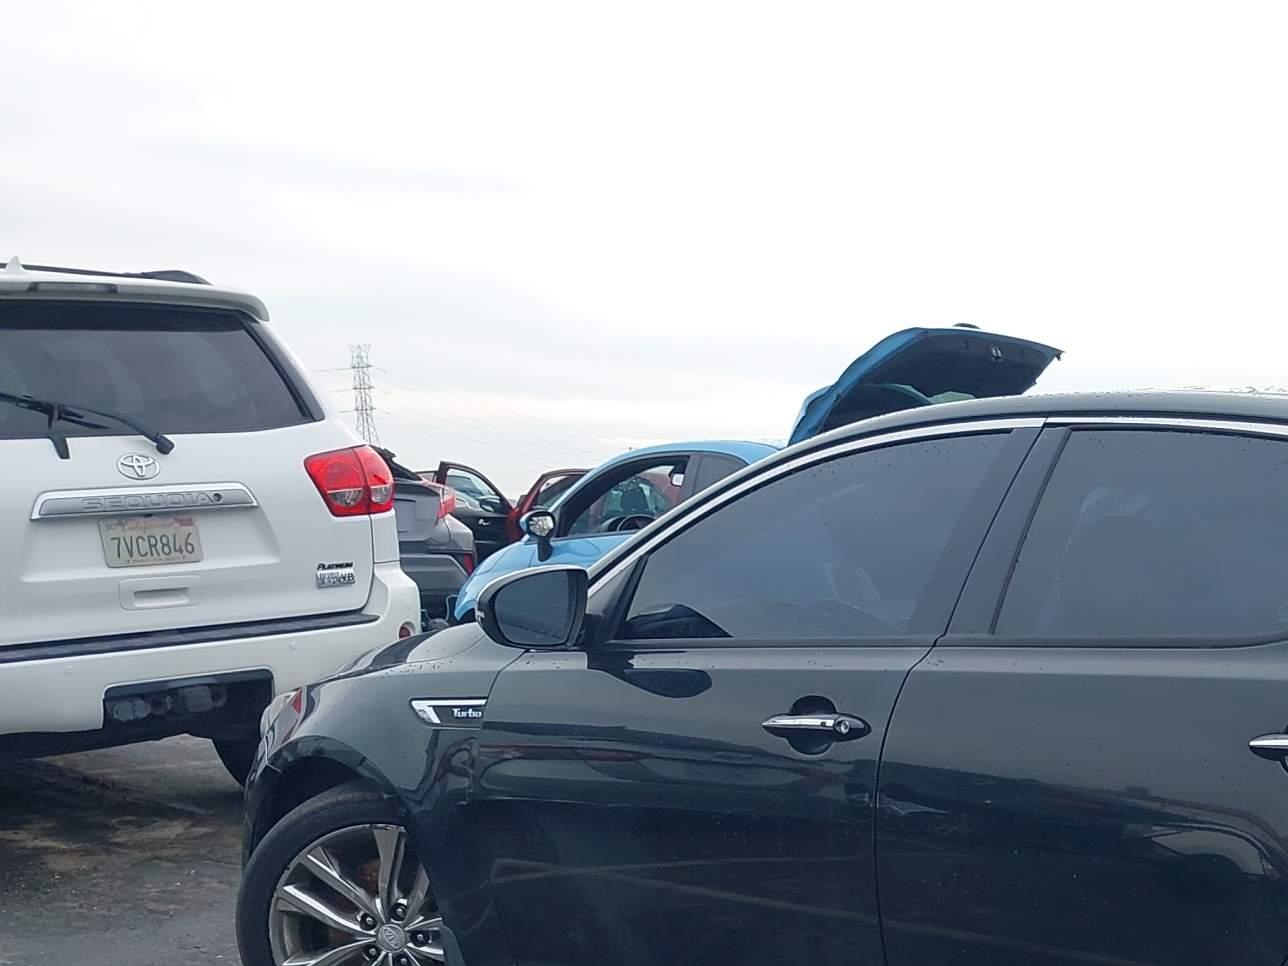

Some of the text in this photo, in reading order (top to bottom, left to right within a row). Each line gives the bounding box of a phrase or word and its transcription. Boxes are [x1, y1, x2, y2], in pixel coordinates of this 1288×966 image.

[82, 492, 215, 510] SEQUOIA
[110, 532, 195, 559] 7VCR846
[452, 708, 482, 718] Turbo
